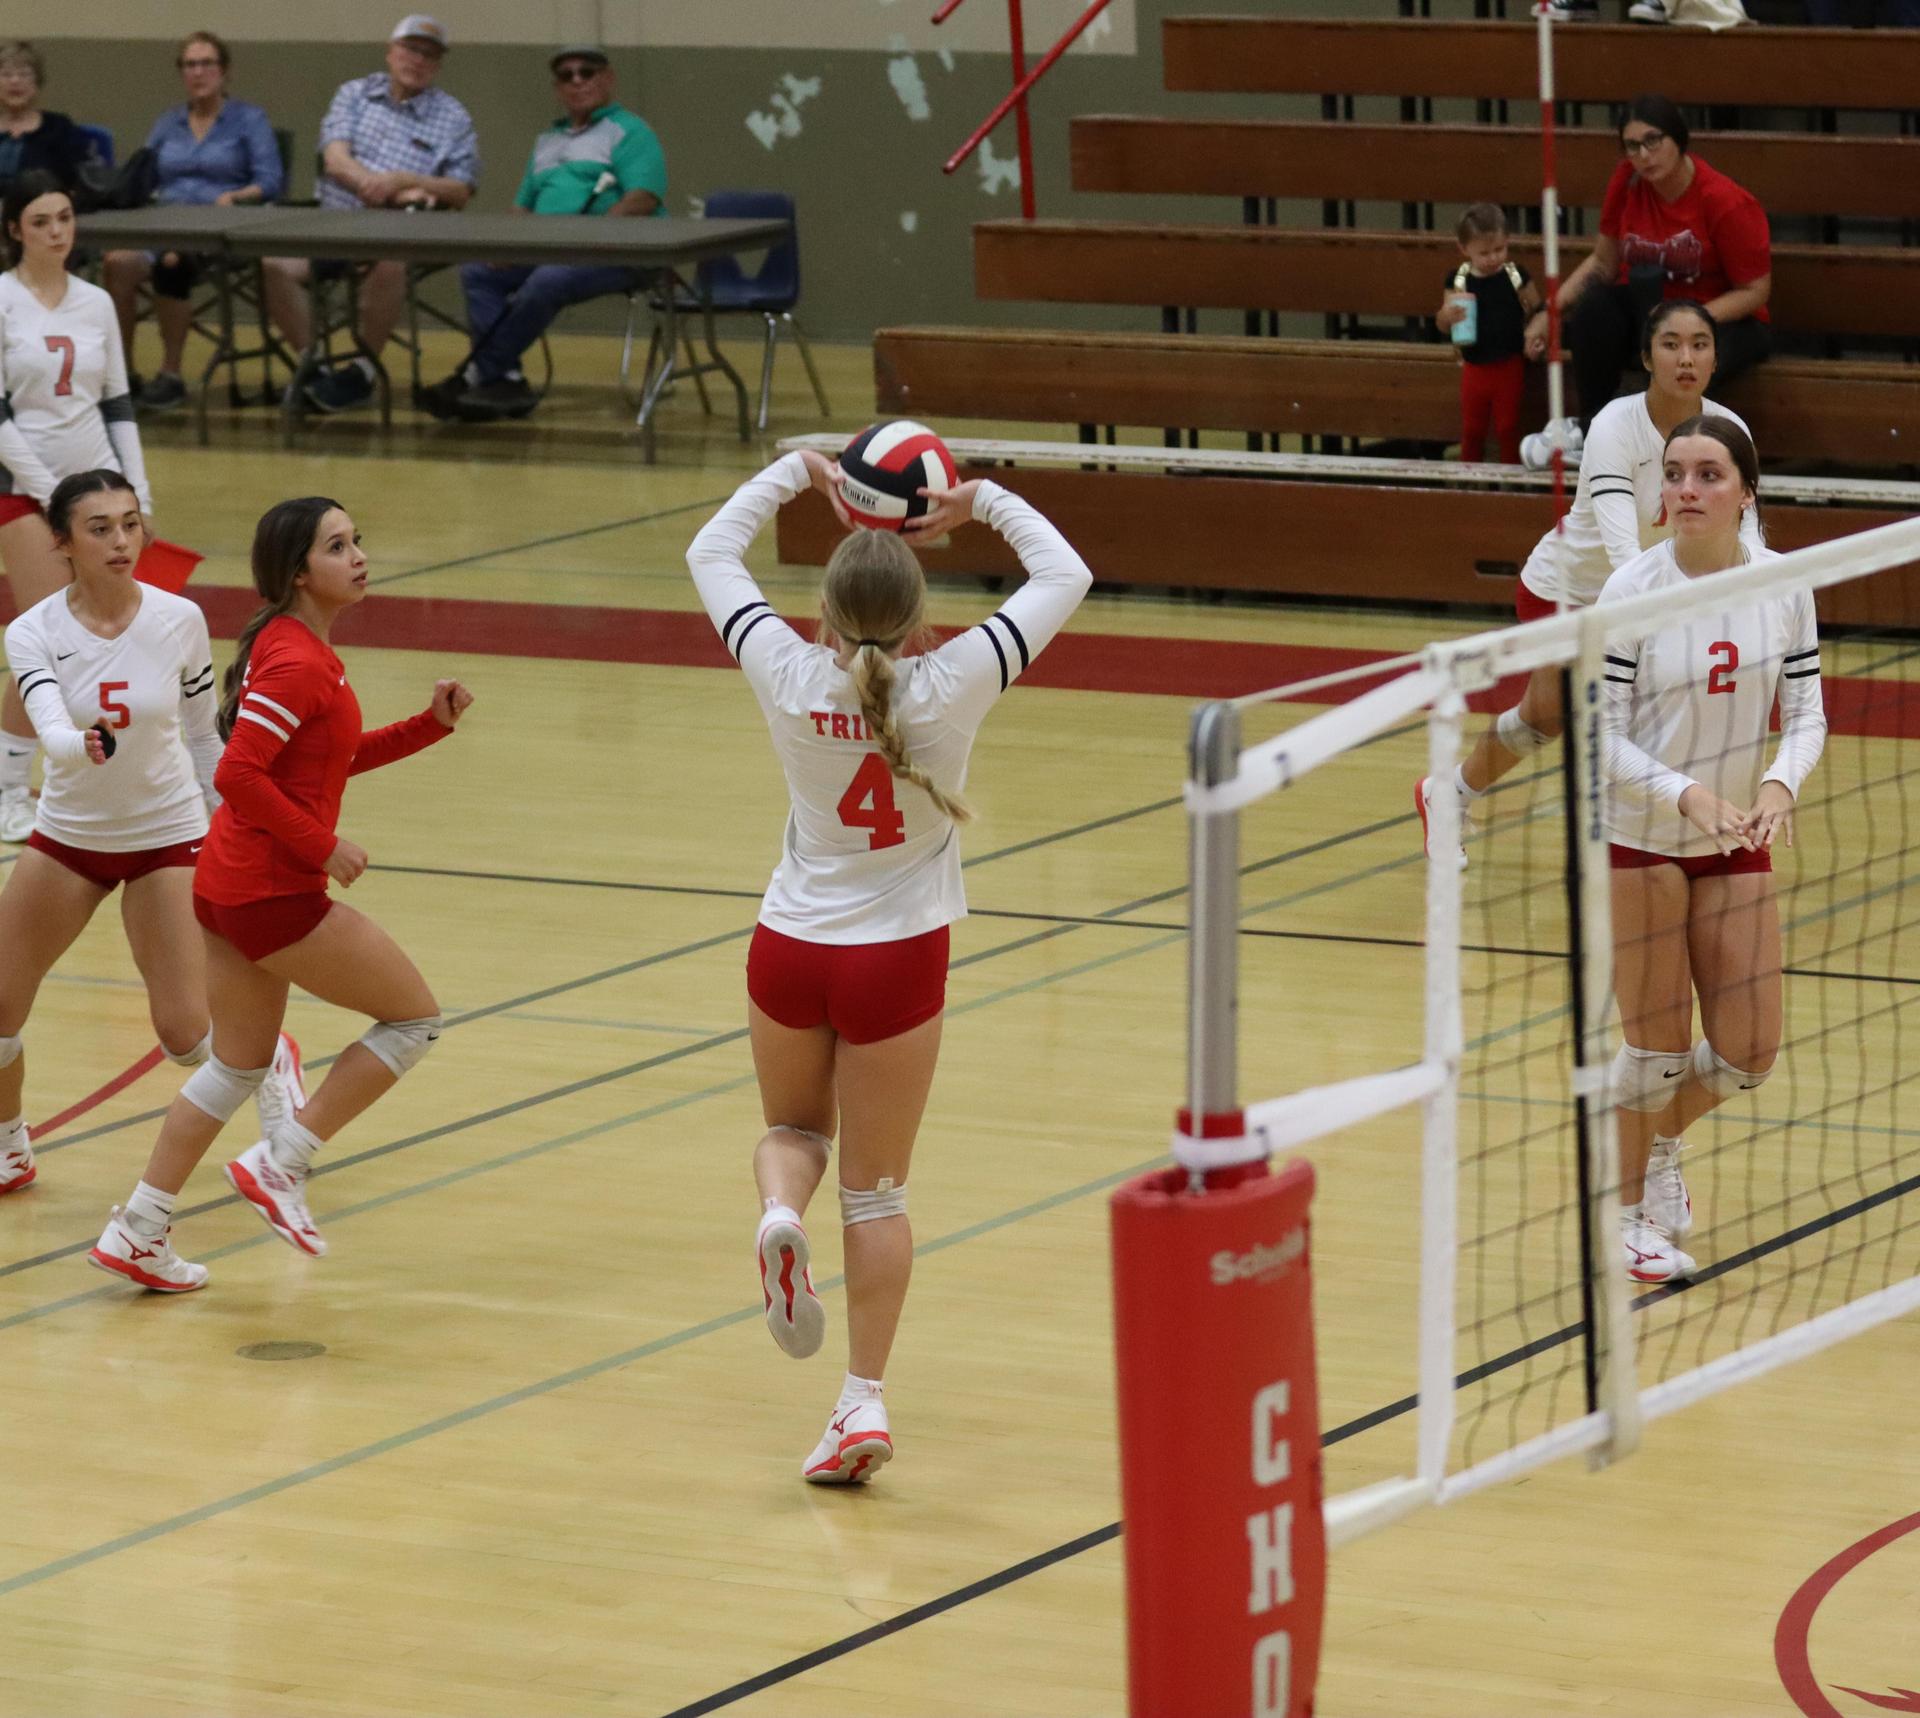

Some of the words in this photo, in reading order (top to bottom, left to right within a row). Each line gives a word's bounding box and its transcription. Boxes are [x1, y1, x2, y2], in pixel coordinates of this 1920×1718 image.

[44, 336, 75, 395] 7
[1708, 641, 1738, 694] 2
[99, 681, 130, 729] 5
[837, 752, 905, 850] 4
